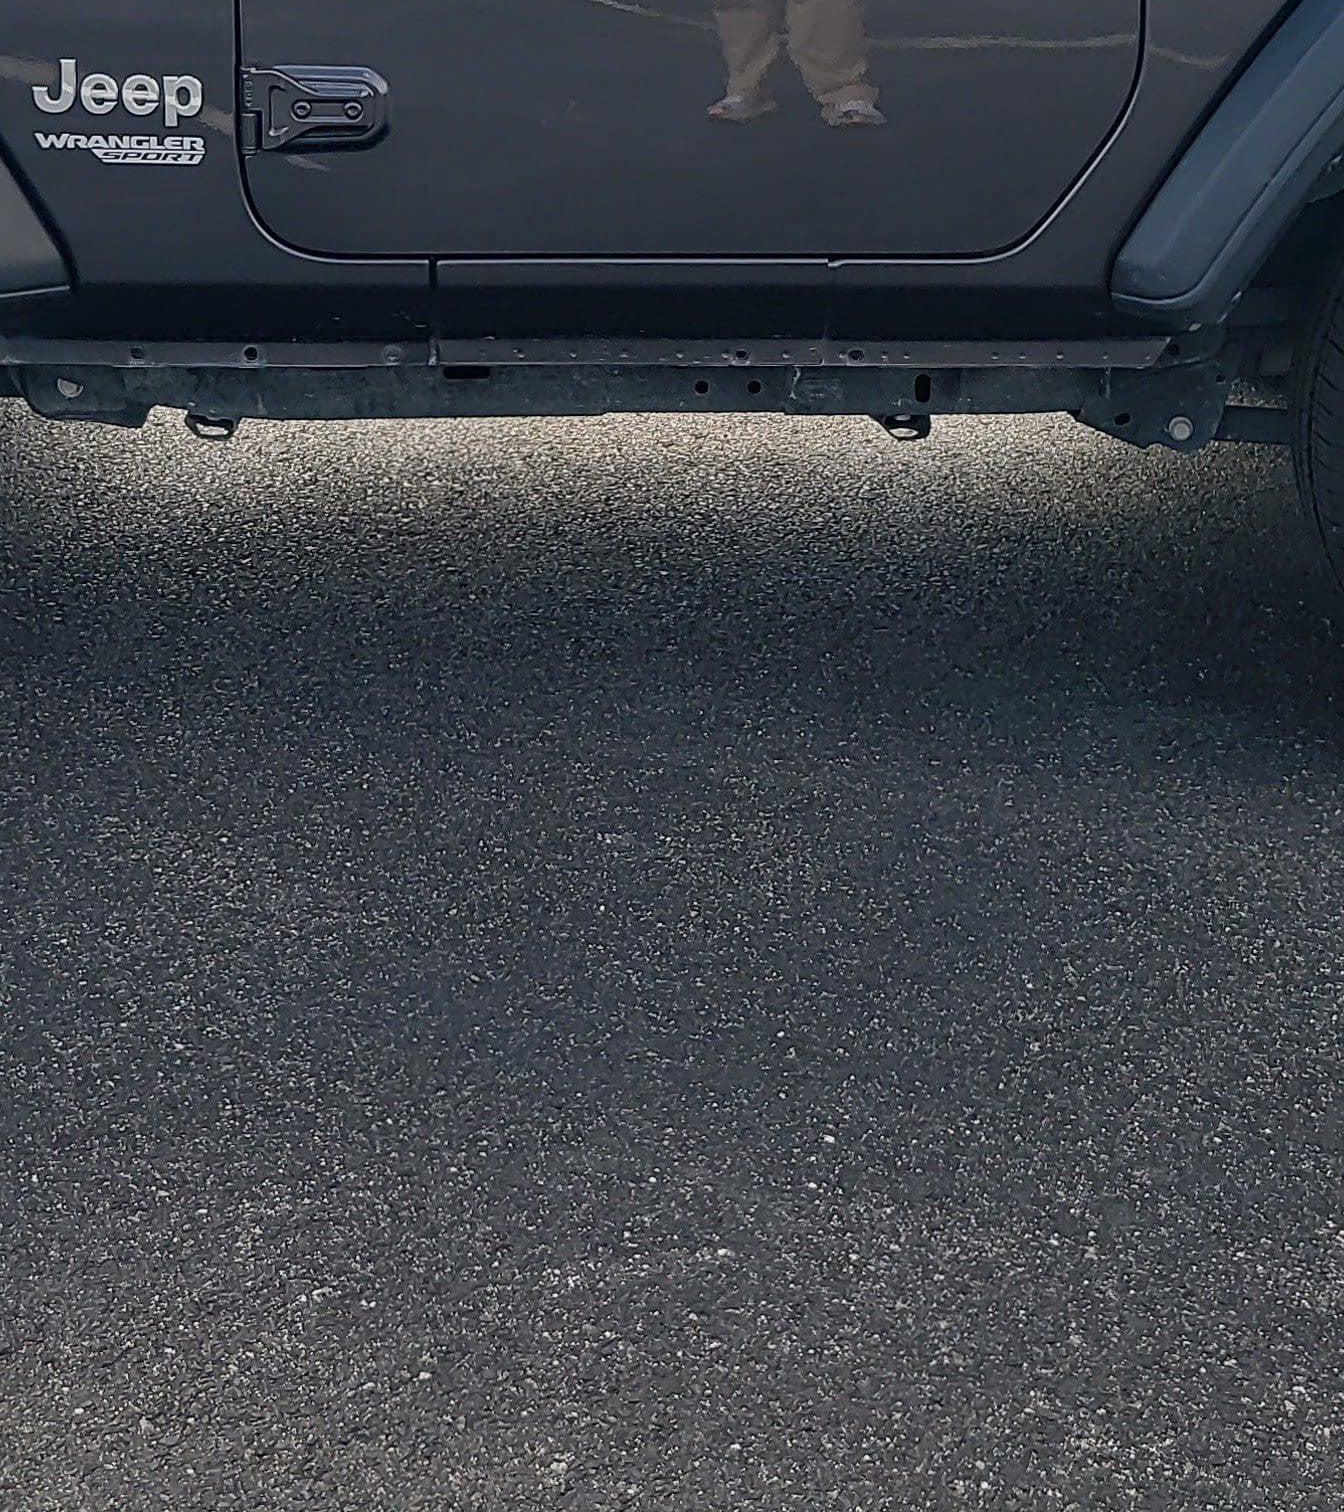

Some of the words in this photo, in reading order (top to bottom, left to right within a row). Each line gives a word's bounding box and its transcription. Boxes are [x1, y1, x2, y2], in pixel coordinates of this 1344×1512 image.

[31, 58, 203, 127] Jeep
[33, 132, 205, 150] WRANGLER
[101, 150, 201, 163] SPORT
